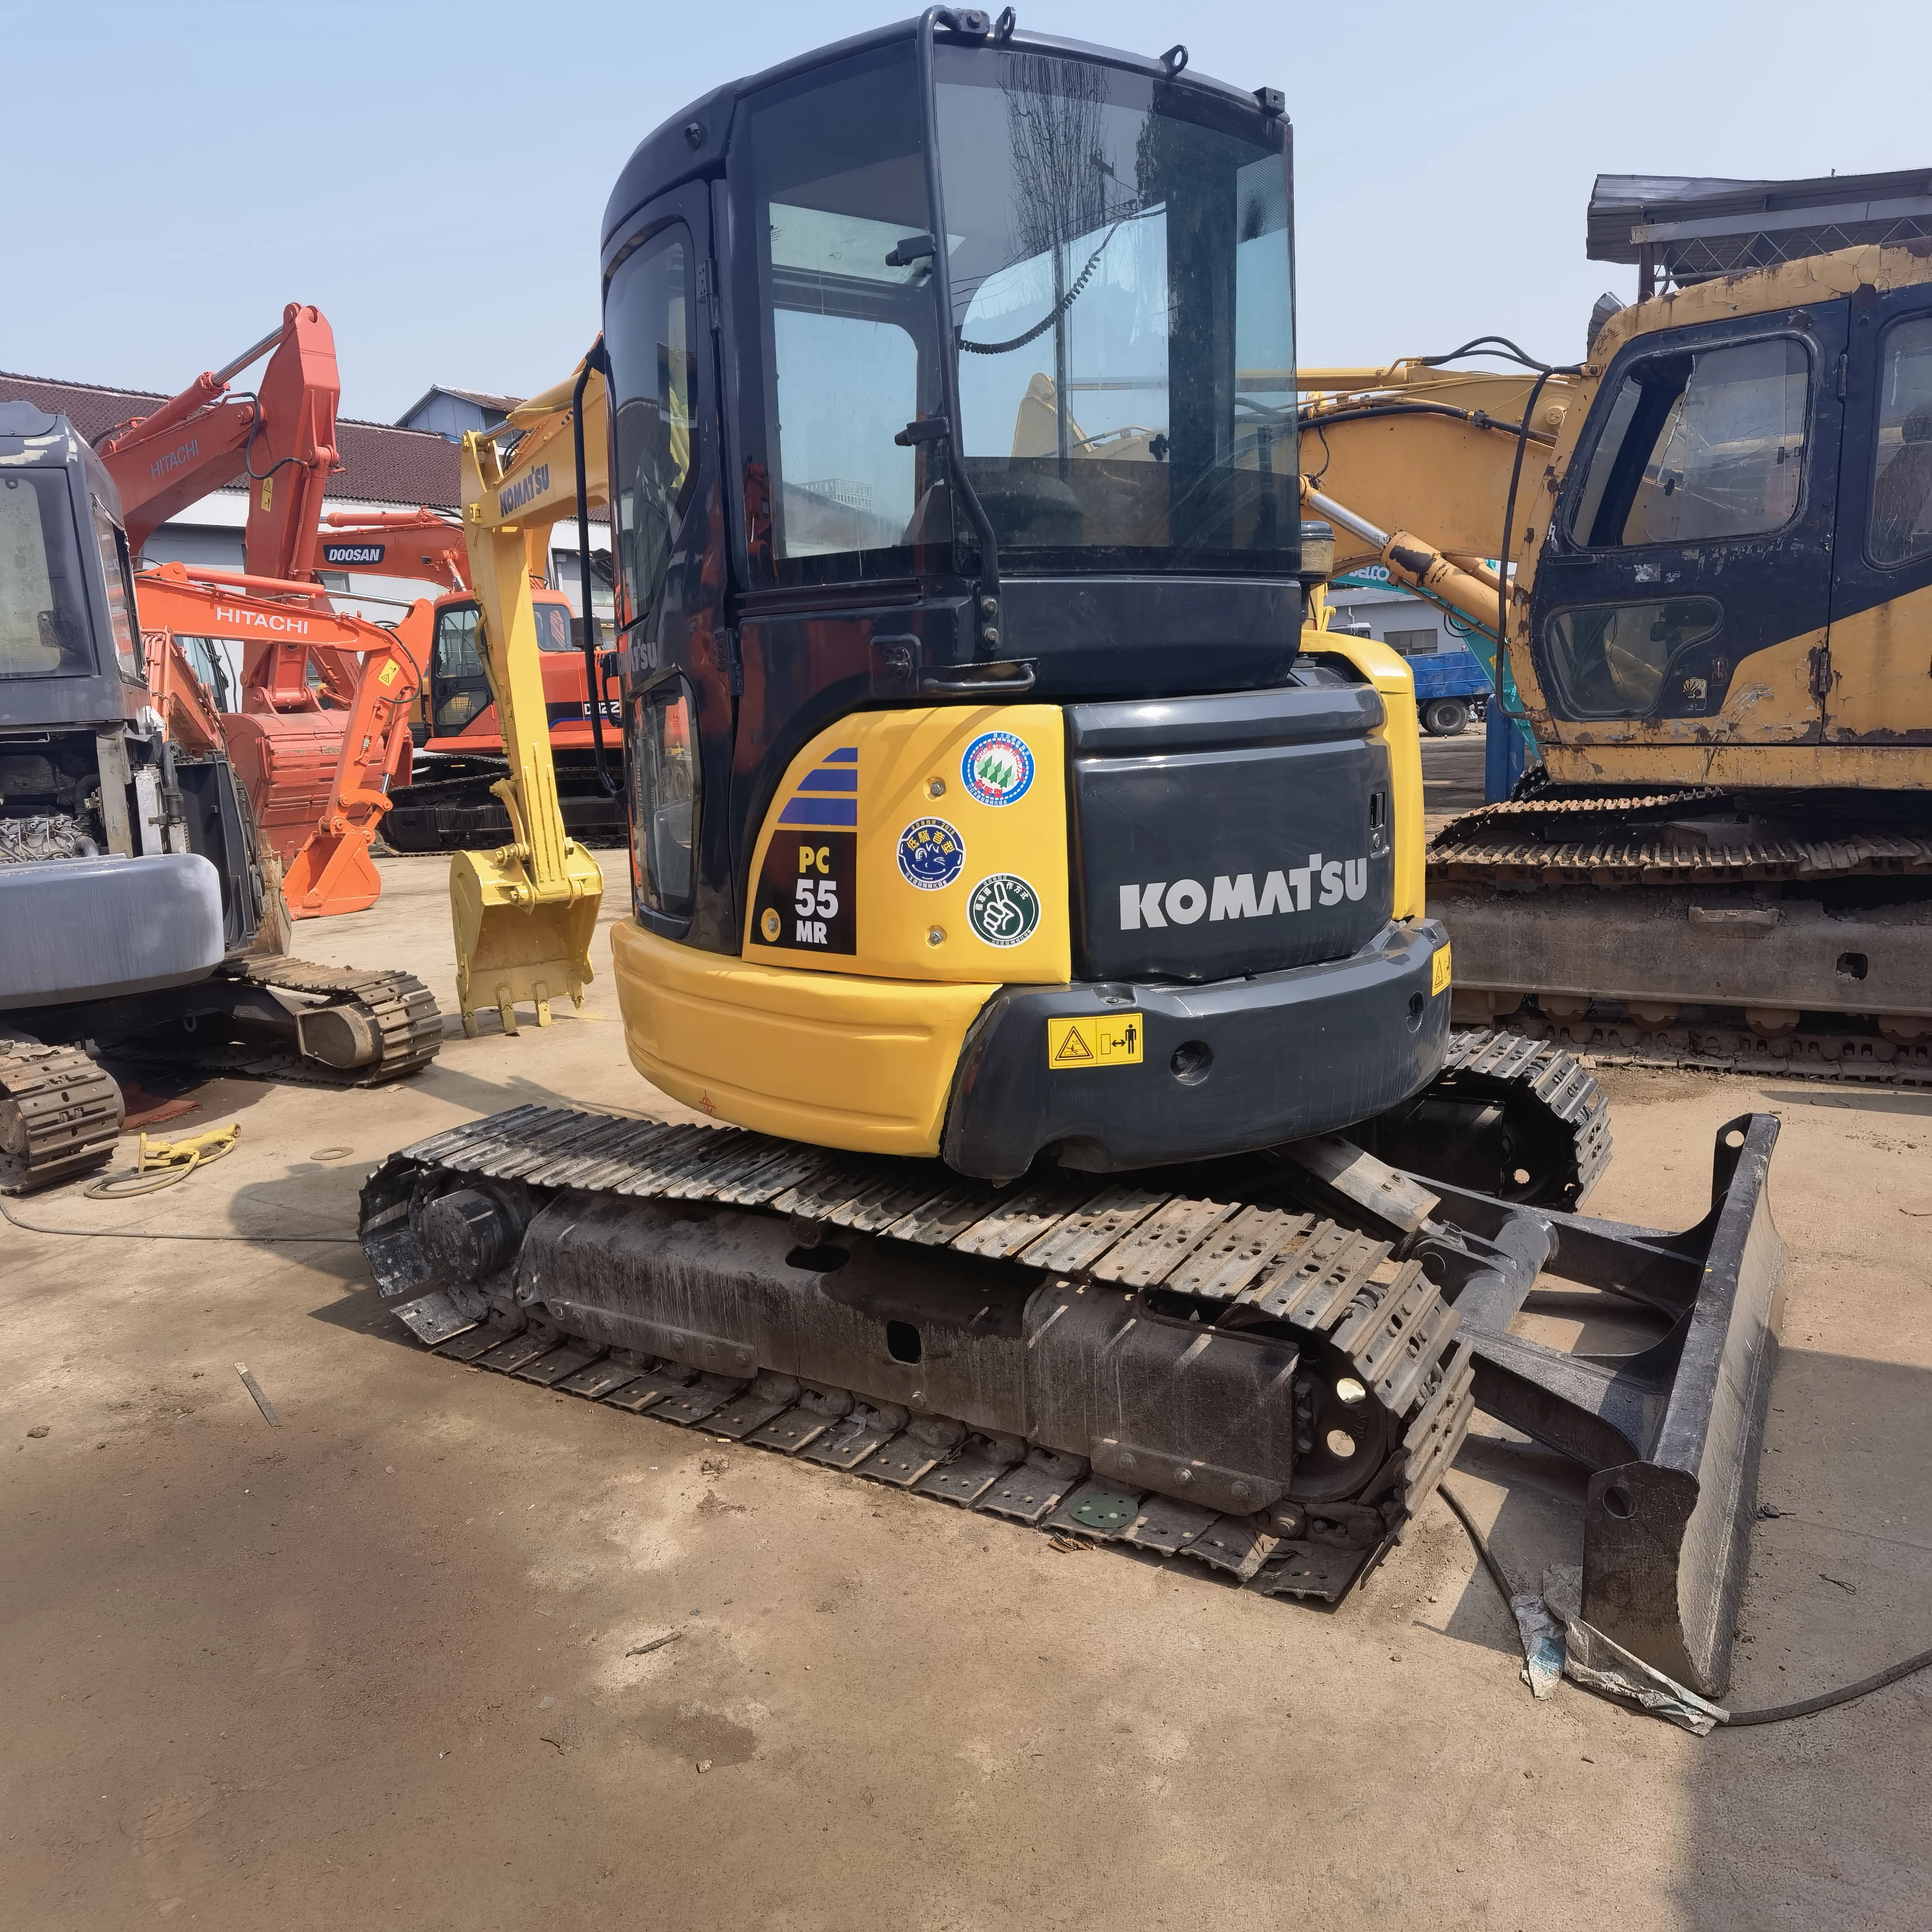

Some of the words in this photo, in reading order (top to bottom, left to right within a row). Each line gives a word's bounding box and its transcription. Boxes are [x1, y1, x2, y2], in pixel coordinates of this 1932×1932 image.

[151, 439, 199, 479] HITACHI
[499, 463, 549, 517] KOMATSU
[329, 549, 380, 561] DOOSAN
[216, 607, 308, 634] HITACHI
[799, 846, 830, 874] PC
[795, 878, 838, 918] 55
[1119, 853, 1367, 930] KOMATSU
[796, 920, 827, 944] MR
